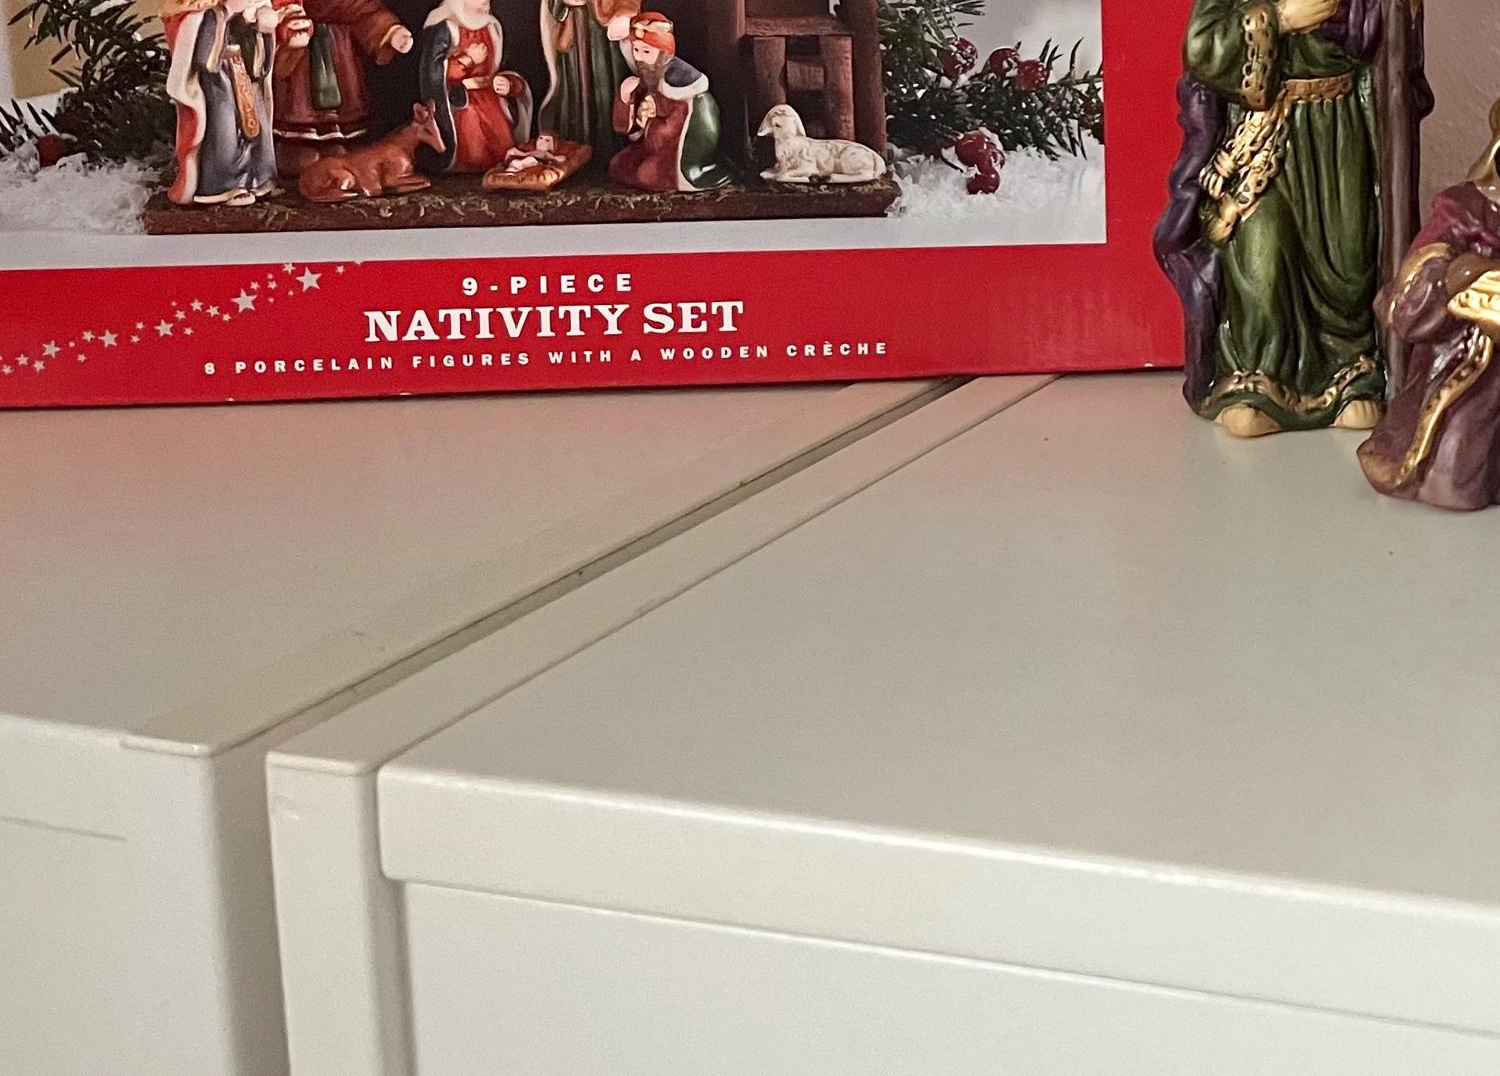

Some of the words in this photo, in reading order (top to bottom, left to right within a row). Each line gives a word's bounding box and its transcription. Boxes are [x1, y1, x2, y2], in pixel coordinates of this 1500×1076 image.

[462, 273, 632, 296] 9-PIECE
[363, 303, 630, 342] NATIVITY
[643, 300, 744, 334] SET
[204, 362, 216, 375] 8
[235, 356, 393, 374] PORCELAIN
[412, 352, 529, 369] FIGURES
[547, 350, 611, 364] WITH
[630, 349, 642, 362] A
[660, 345, 768, 360] WOODEN
[786, 340, 886, 357] CRÈCHE
